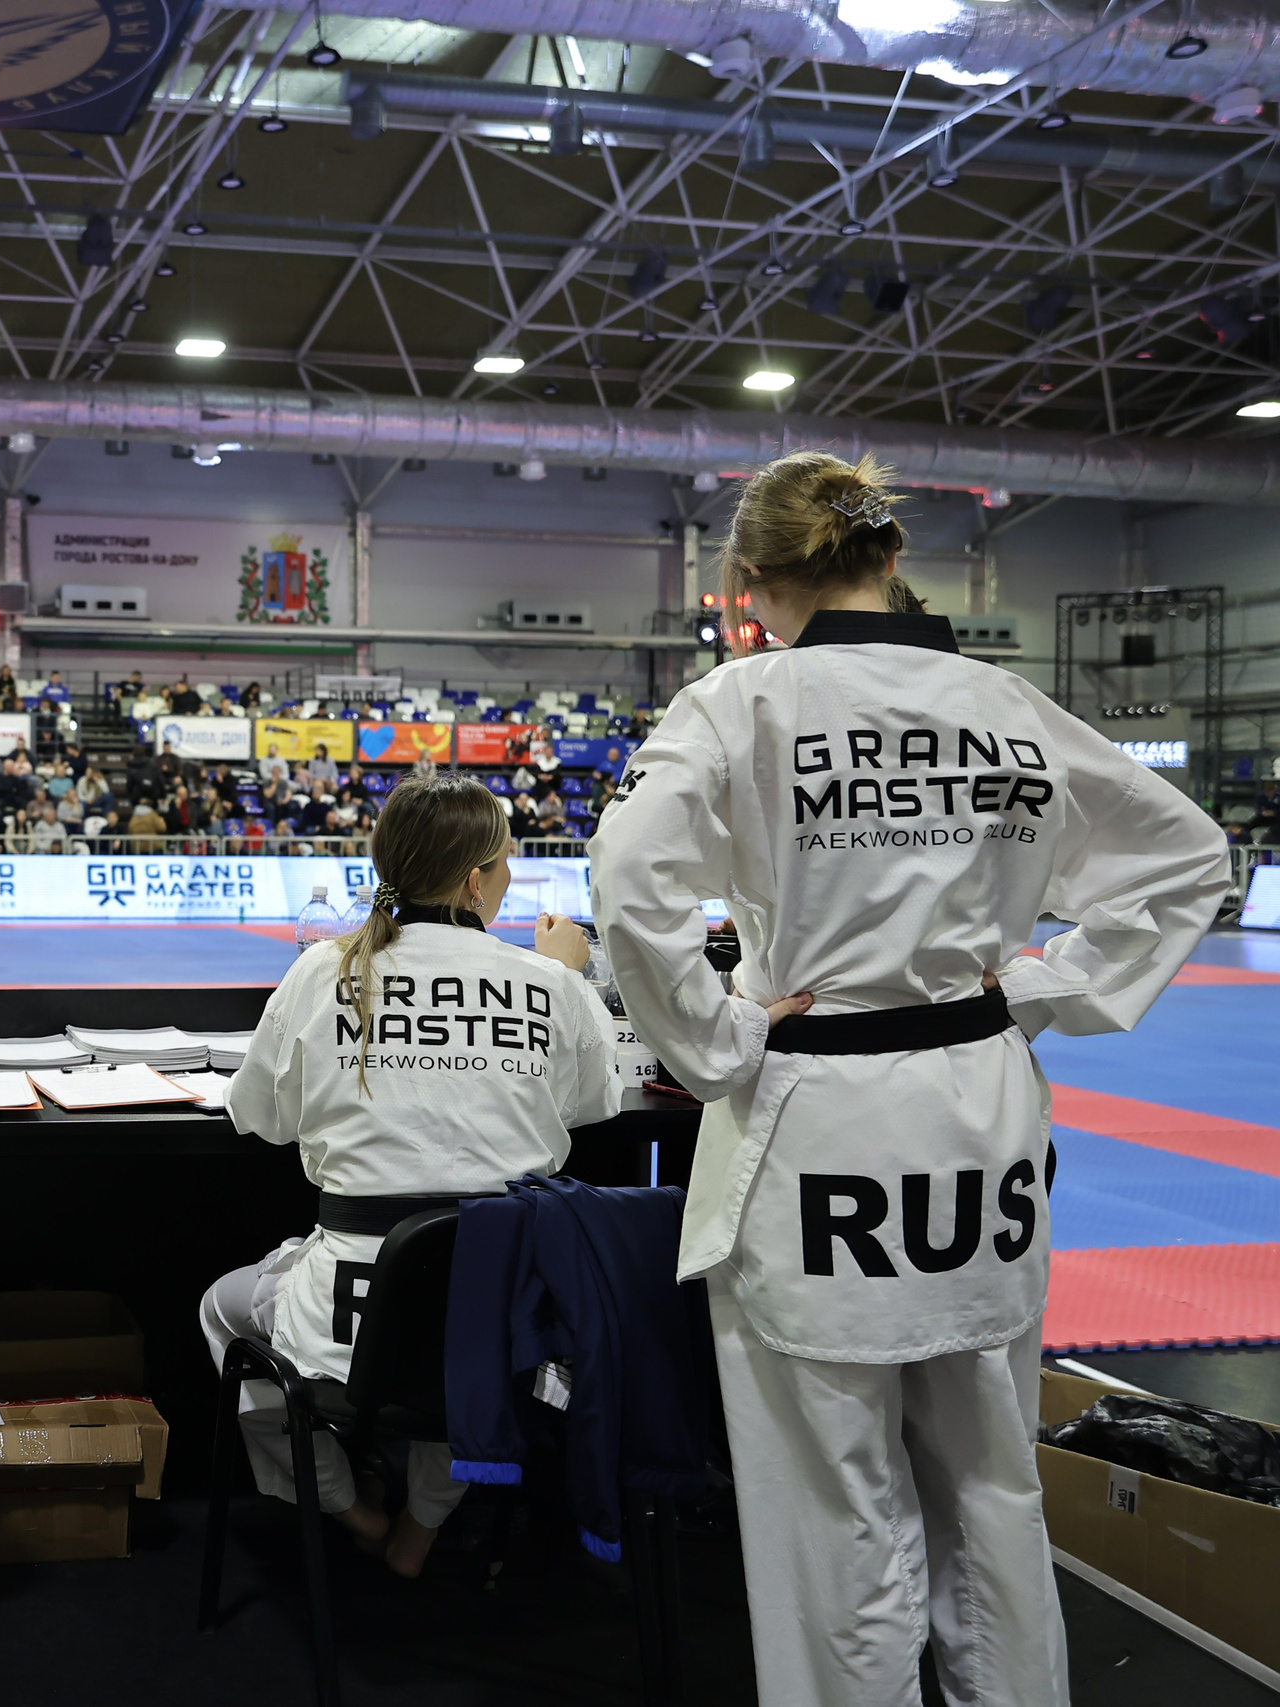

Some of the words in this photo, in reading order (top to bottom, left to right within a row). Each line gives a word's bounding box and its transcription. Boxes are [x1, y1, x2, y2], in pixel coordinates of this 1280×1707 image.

[54, 551, 97, 563] ГОРОДА
[794, 728, 1047, 774] GRAND
[793, 776, 1053, 825] MASTER
[795, 827, 974, 852] TAEKWONDO
[983, 824, 1038, 844] CLUB
[145, 864, 253, 879] GRAND
[146, 882, 254, 897] MASTER
[336, 975, 551, 1018] GRAND
[336, 1014, 550, 1058] MASTER
[617, 1031, 642, 1043] 22
[337, 1055, 488, 1070] TAEKWONDO
